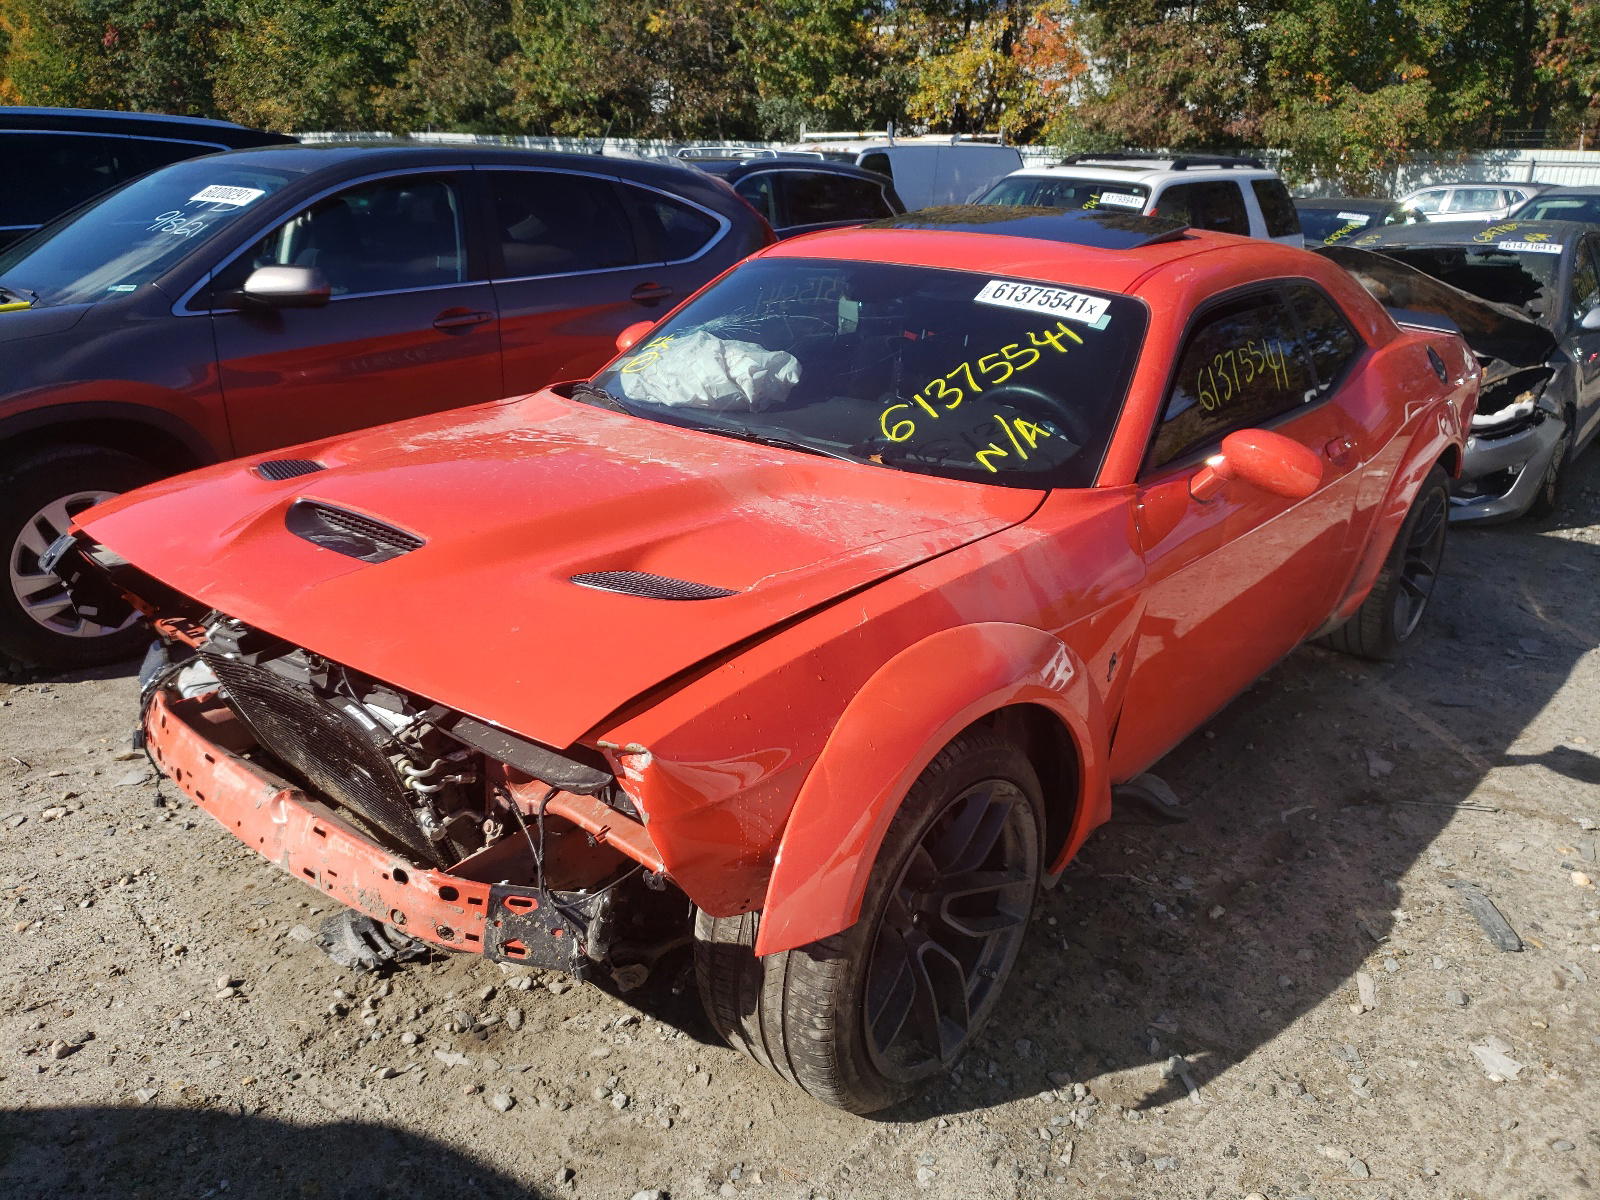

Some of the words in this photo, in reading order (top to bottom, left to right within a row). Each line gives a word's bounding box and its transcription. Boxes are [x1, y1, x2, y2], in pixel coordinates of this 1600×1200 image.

[880, 321, 1083, 443] 61375541
[1198, 338, 1289, 411] 61375541
[975, 414, 1051, 473] N/A
